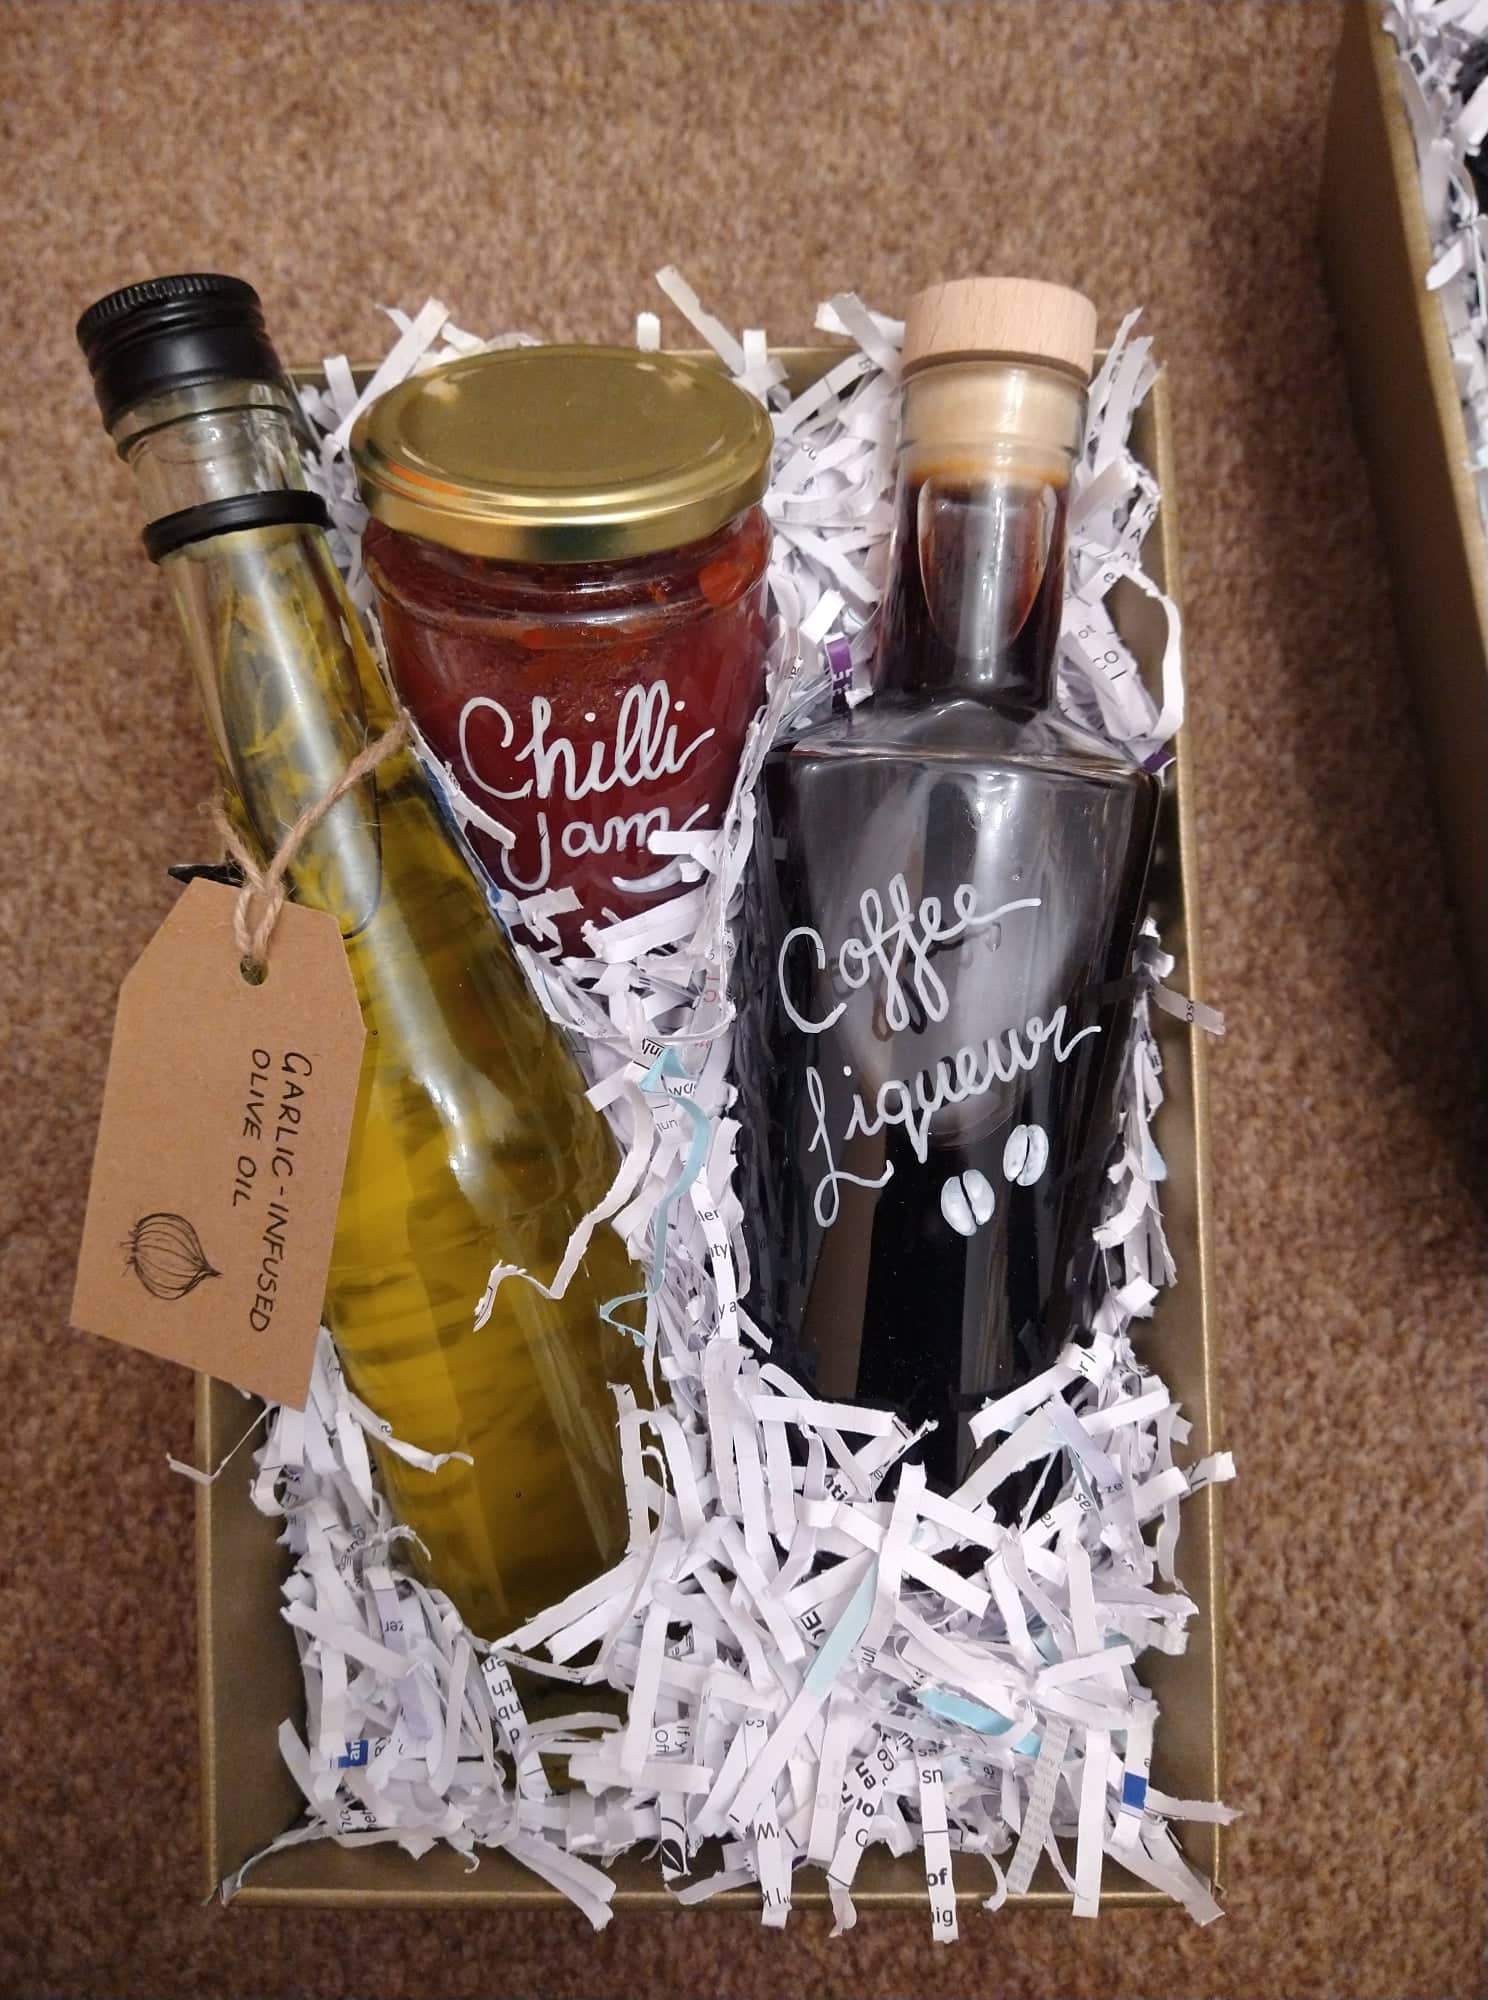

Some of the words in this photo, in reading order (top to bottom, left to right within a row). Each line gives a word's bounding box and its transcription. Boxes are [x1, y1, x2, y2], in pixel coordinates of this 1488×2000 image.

[458, 679, 716, 801] Chilli
[777, 872, 1042, 1034] Coffee
[242, 1048, 271, 1141] OLIVE
[805, 1004, 1102, 1228] Liqueur
[232, 1155, 257, 1208] OIL
[249, 1052, 313, 1332] GARLIC-INFUSED
[927, 1867, 949, 1887] of
[931, 1907, 954, 1928] ig
